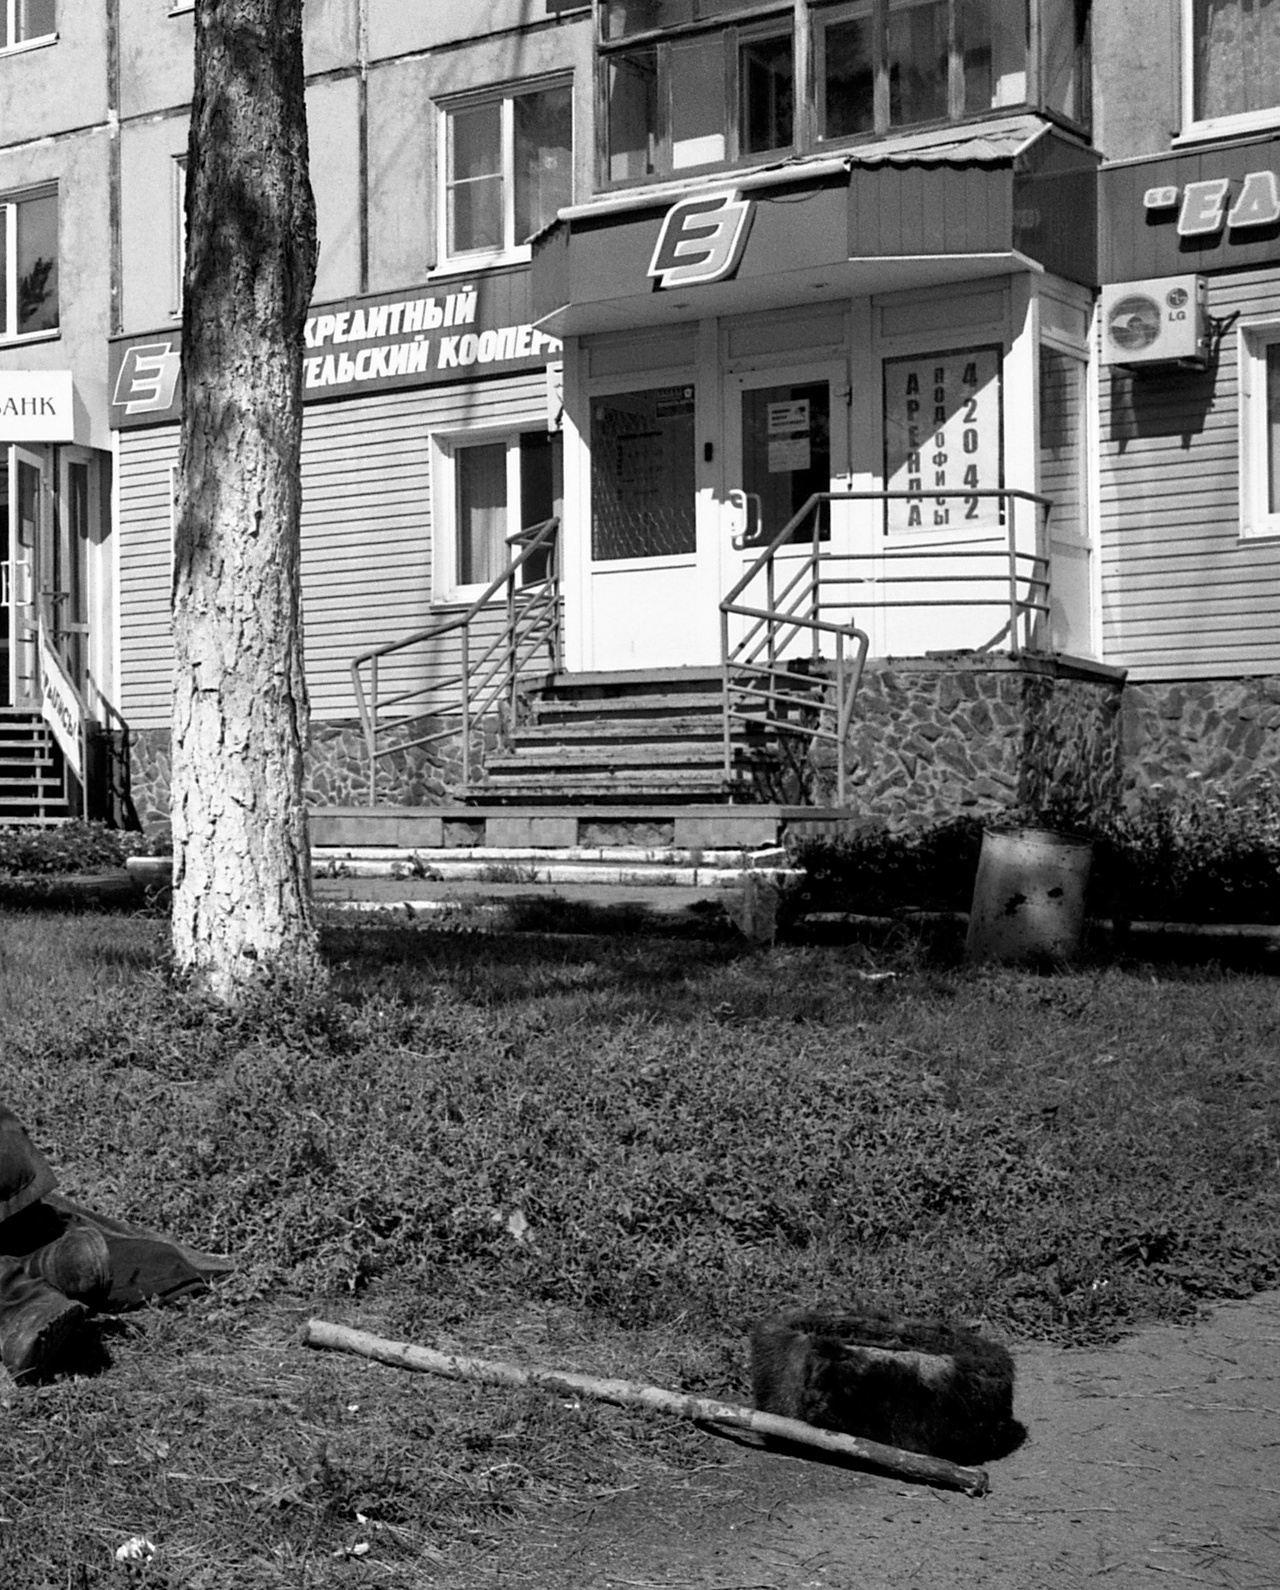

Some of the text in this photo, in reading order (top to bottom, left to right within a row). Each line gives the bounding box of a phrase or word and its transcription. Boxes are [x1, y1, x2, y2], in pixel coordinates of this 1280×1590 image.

[1168, 310, 1186, 322] LG
[933, 367, 947, 426] ПОД
[962, 362, 980, 520] 42042
[906, 373, 923, 527] АРЕНДА
